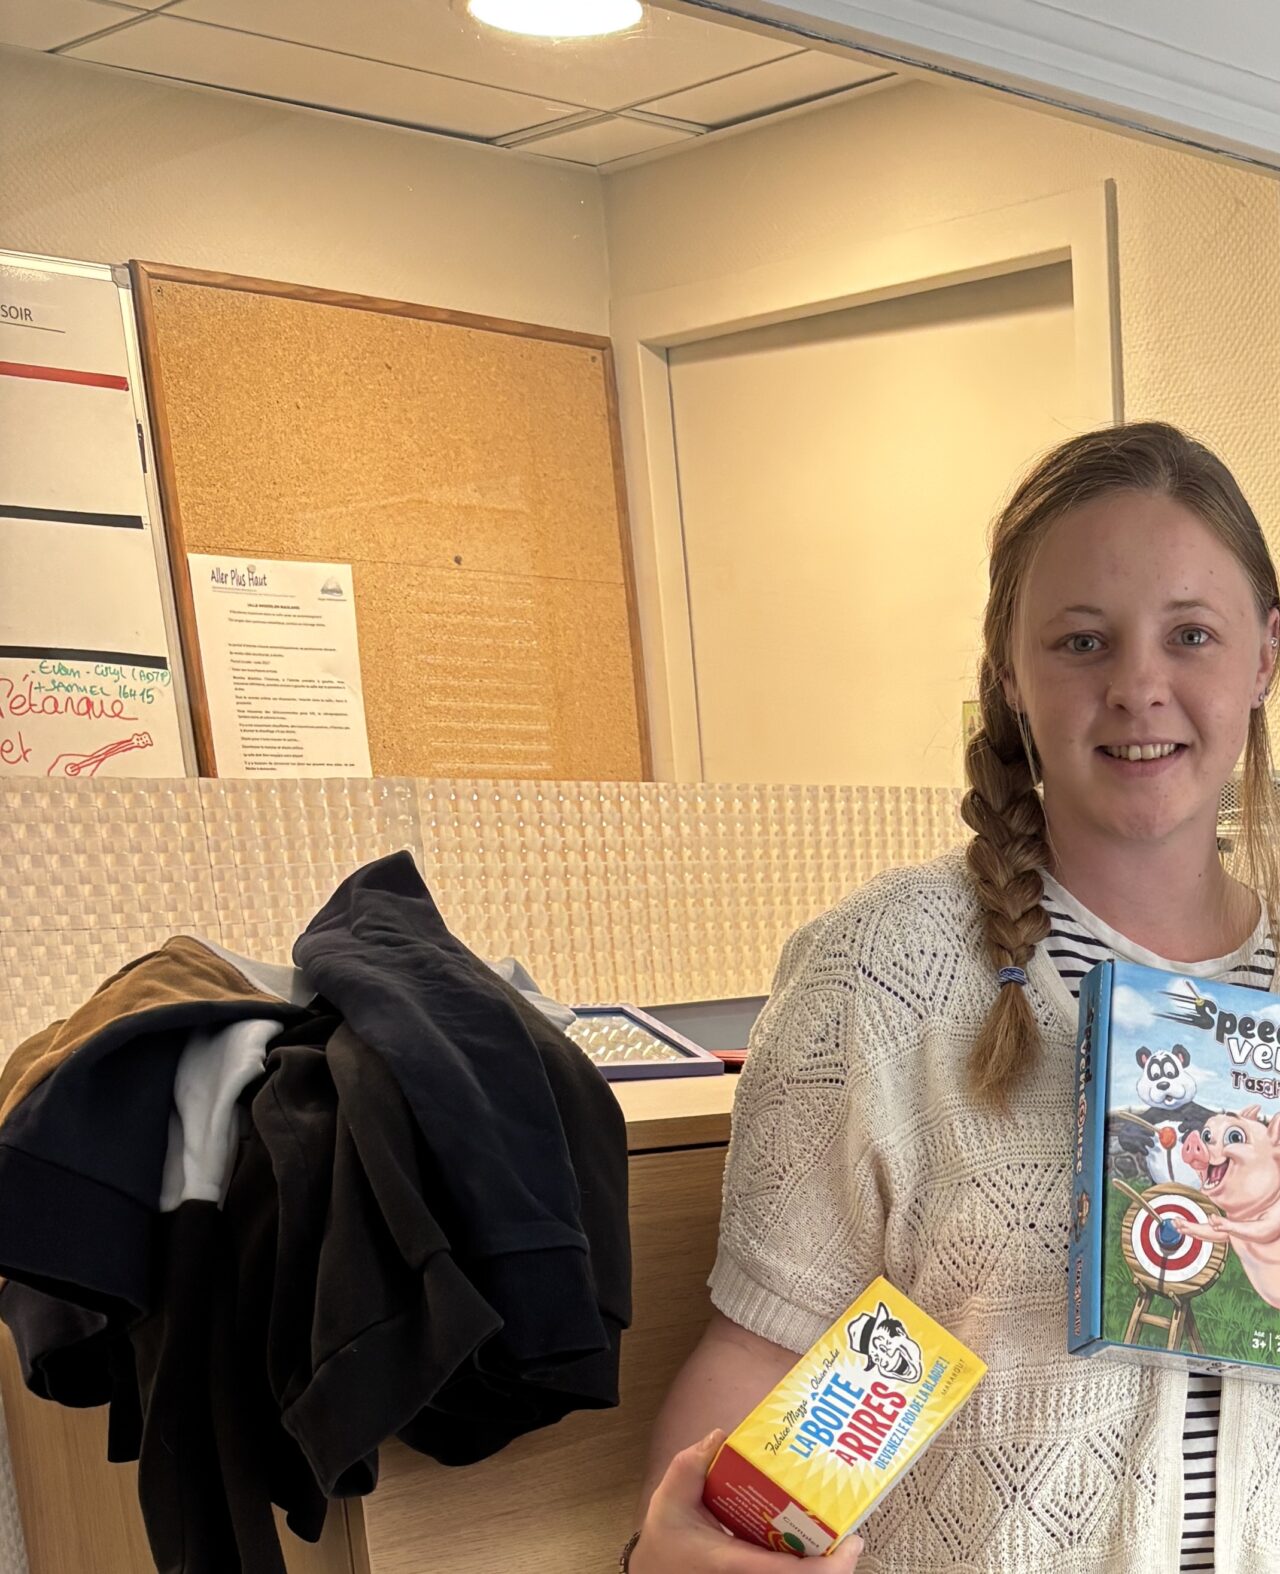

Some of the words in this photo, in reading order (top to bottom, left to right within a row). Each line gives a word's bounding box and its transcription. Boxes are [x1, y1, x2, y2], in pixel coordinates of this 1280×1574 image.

[0, 304, 33, 321] SOIR
[211, 567, 229, 584] Aller
[230, 568, 246, 587] Plus
[247, 569, 267, 587] Haut
[1252, 1338, 1266, 1349] 3+
[922, 1359, 948, 1393] BLAGUE
[910, 1398, 925, 1413] DE
[916, 1388, 932, 1403] LA
[800, 1372, 865, 1447] BOÎTE
[901, 1408, 918, 1428] ROI
[765, 1425, 790, 1455] Fabrice
[783, 1400, 808, 1427] Mazza
[837, 1381, 907, 1461] RIRES
[895, 1422, 911, 1437] LE
[789, 1434, 817, 1459] LA
[874, 1431, 904, 1470] DEVENEZ
[830, 1449, 858, 1467] À
[782, 1515, 820, 1549] Complet
